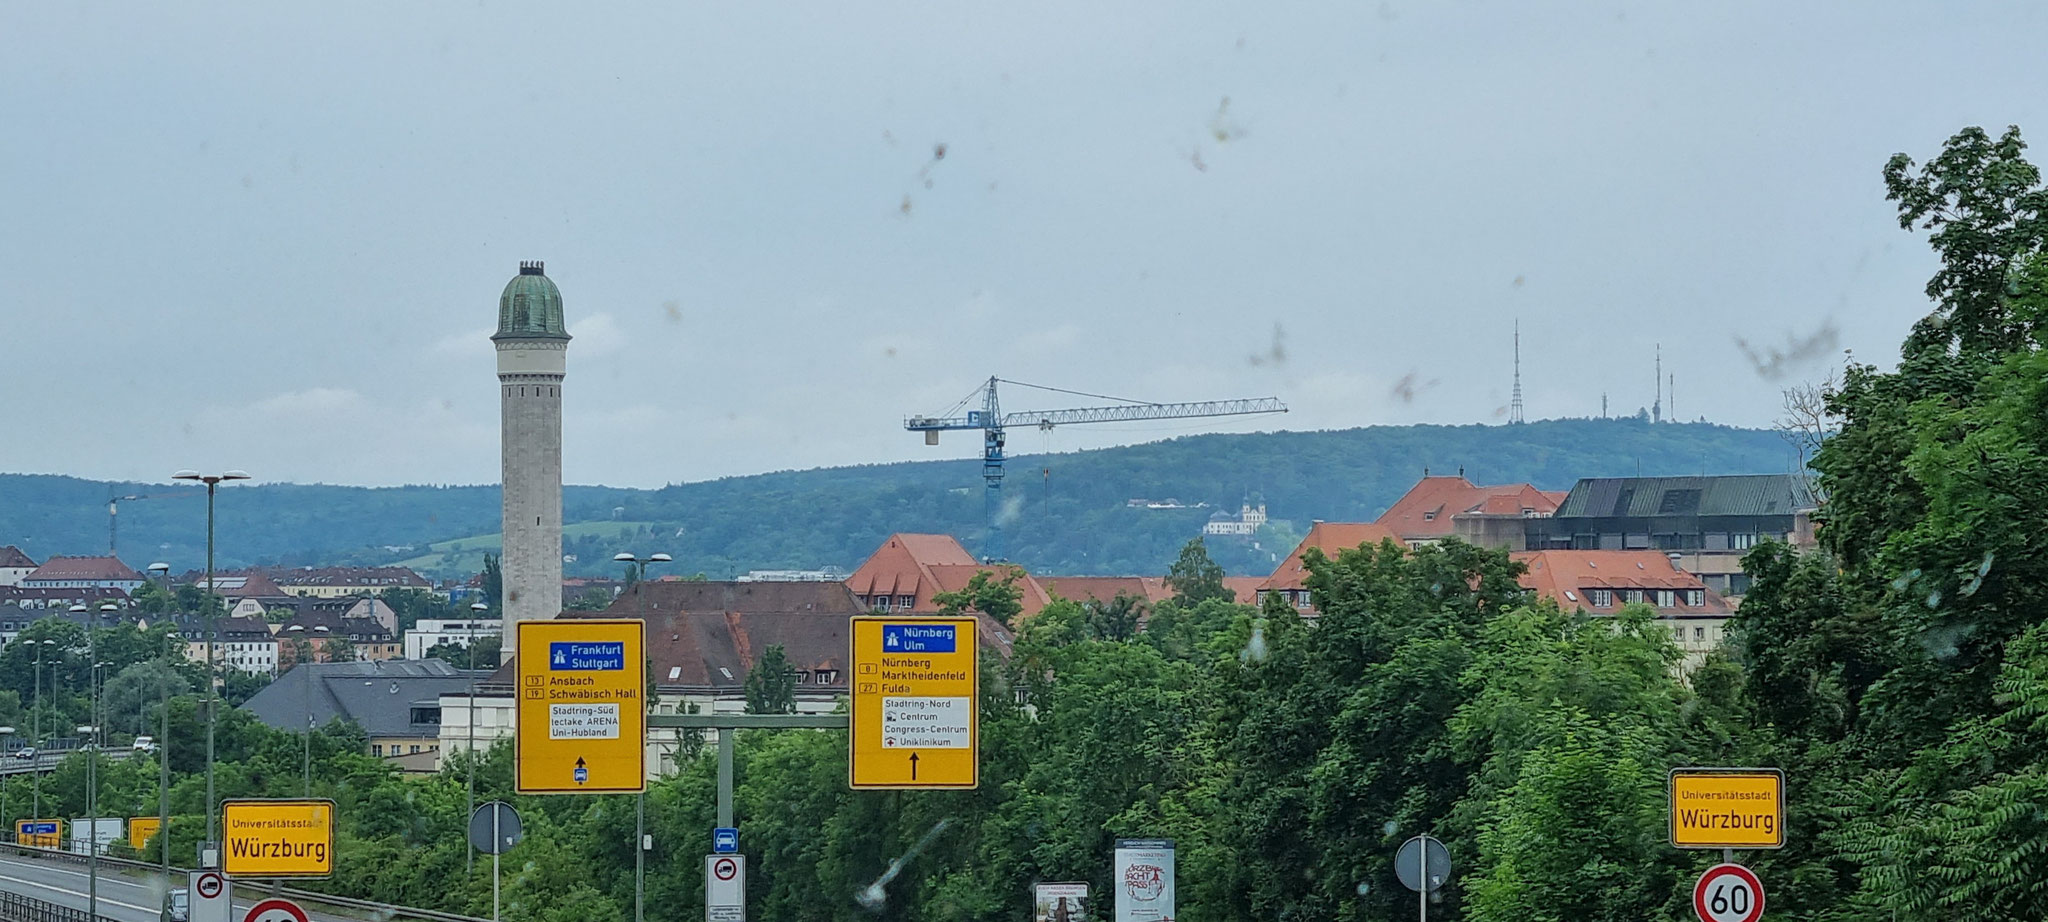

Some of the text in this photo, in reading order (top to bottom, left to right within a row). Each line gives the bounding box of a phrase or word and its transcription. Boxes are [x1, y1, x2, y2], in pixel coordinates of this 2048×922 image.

[904, 628, 953, 639] Nürnberg
[571, 645, 621, 655] Frankfurt
[904, 641, 925, 650] Ulm
[572, 658, 618, 670] Stuttgart
[882, 658, 931, 669] Nürnberg
[882, 671, 966, 680] Marktheidenfeld
[549, 676, 594, 686] Ansbach
[863, 684, 873, 692] 27
[882, 684, 910, 693] Fulda
[549, 689, 636, 699] Schwäbisch Hall
[885, 700, 951, 709] Stadtring-Nord
[552, 706, 614, 716] Stadtring-Süd
[900, 713, 938, 721] Centrum
[552, 728, 607, 737] Uni-Hubland
[885, 725, 968, 734] Congress-Centrum
[900, 738, 951, 746] Uniklinikum
[1681, 790, 1771, 800] Universitätsstadt
[232, 819, 323, 829] Universitätssta
[1680, 808, 1774, 834] Würzburg
[231, 837, 325, 863] Würzburg
[1711, 884, 1748, 915] 60
